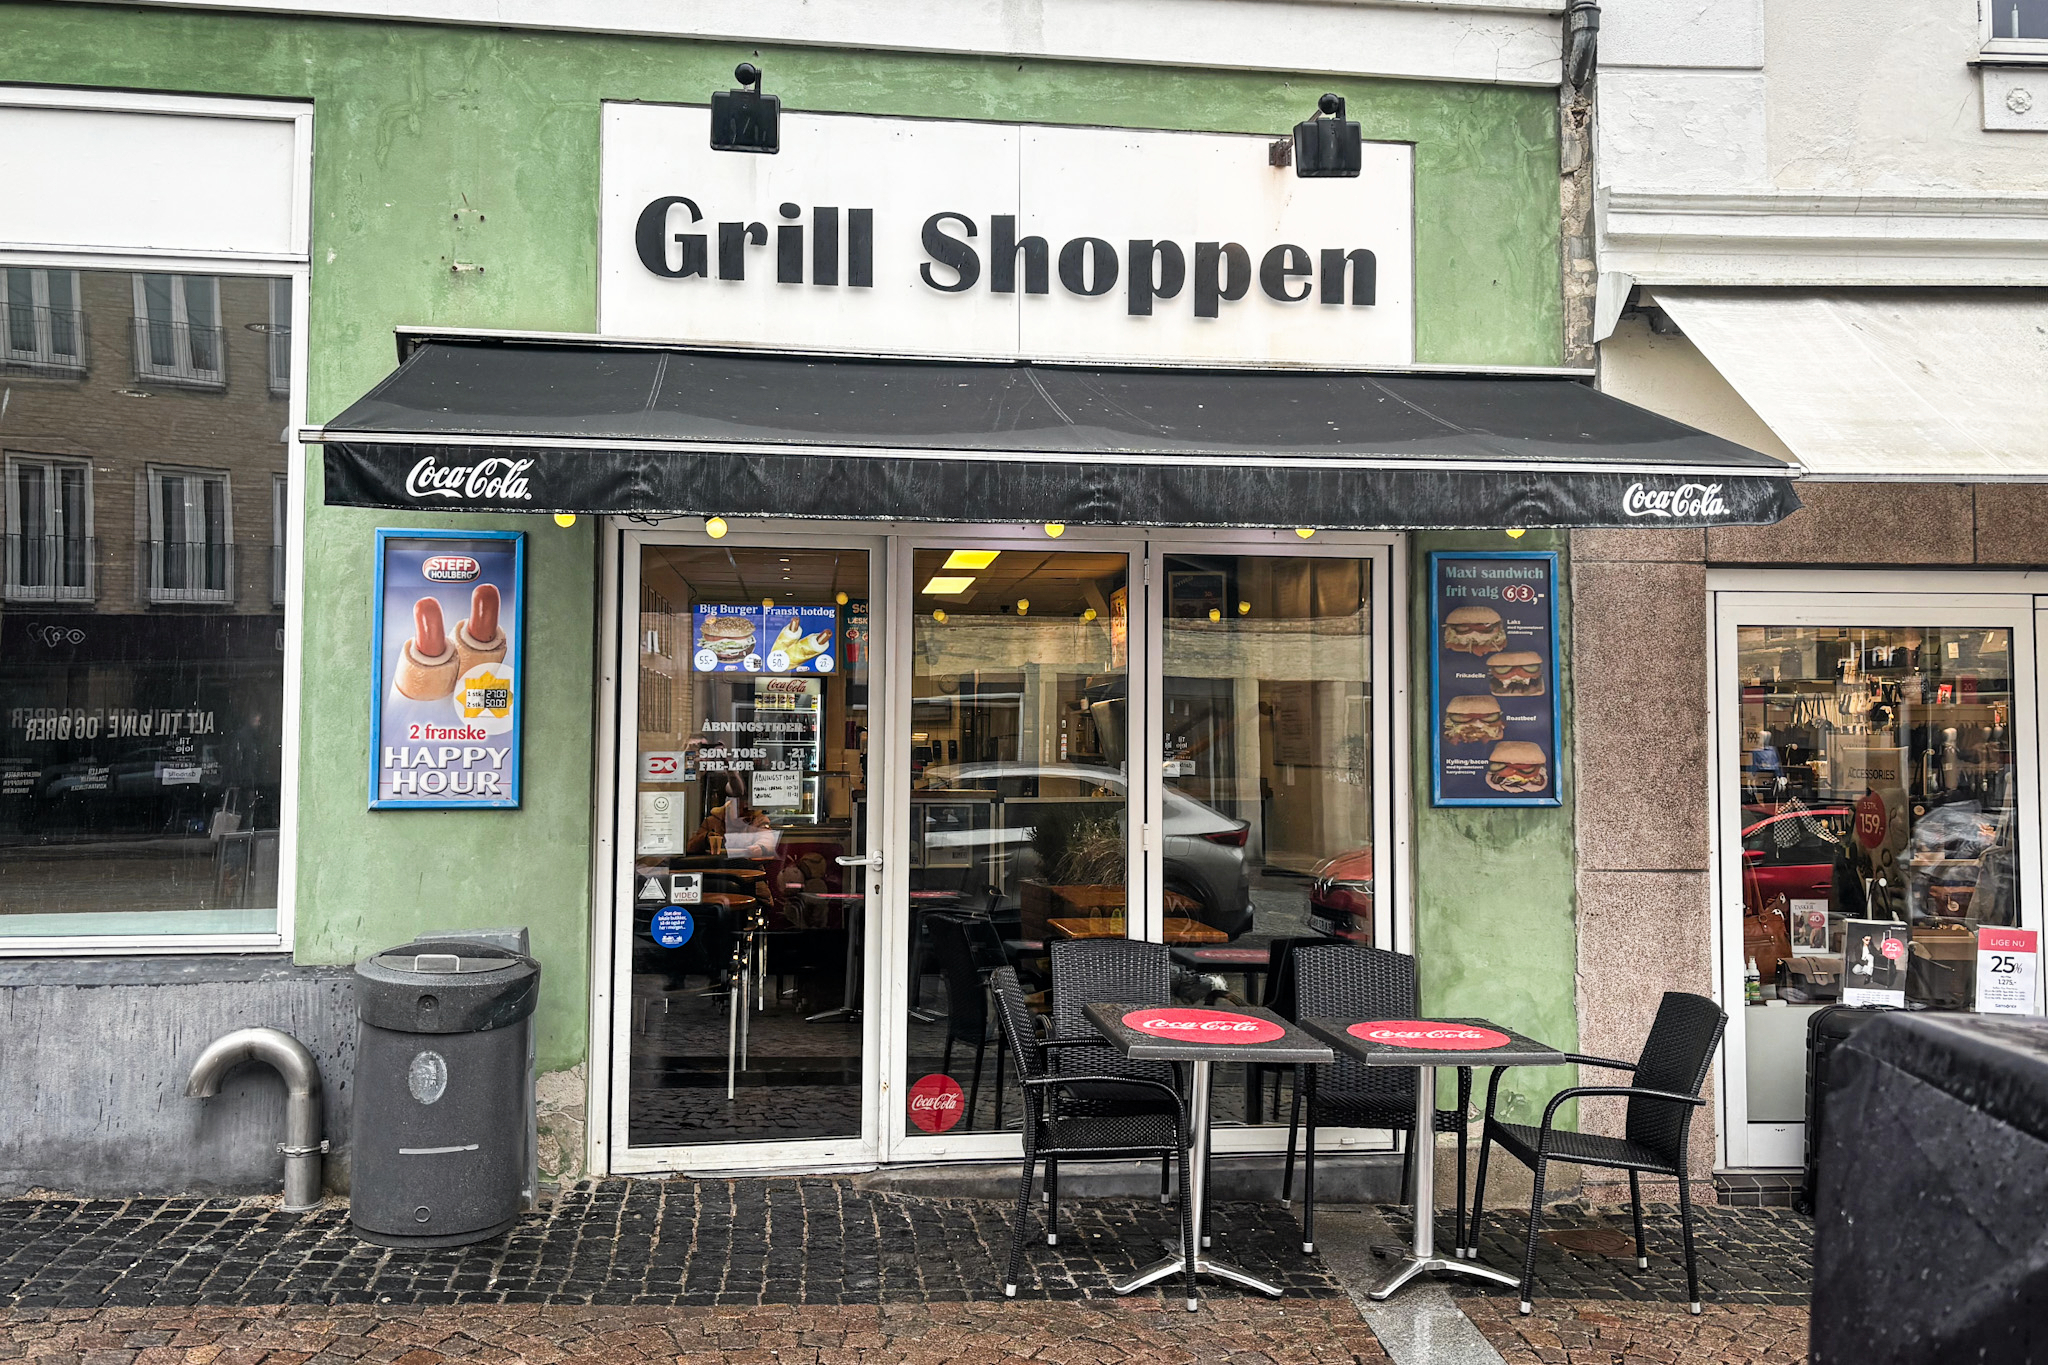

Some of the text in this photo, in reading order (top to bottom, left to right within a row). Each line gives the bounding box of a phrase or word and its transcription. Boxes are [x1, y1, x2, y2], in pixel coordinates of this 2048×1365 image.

[635, 195, 1377, 319] Grill Shoppen
[405, 455, 535, 500] Coca-Cola
[1622, 482, 1731, 517] Coca-Cola
[431, 558, 473, 571] STEFF
[431, 570, 473, 580] HOULBERG
[1445, 566, 1544, 579] Maxi sandwich
[1445, 585, 1499, 600] frit valg
[699, 603, 758, 616] Big Burger
[765, 606, 835, 618] Fransk hotdog
[766, 679, 808, 693] Coca-Cola
[409, 723, 487, 740] 2 franske
[701, 718, 807, 733] ÅBNINGSTIDER:
[384, 746, 511, 770] HAPPY
[698, 747, 767, 759] SØN-TORS
[698, 760, 804, 772] FRE-LØR 10-21
[1847, 767, 1896, 781] ACCESSORIES
[391, 771, 503, 795] HOUR
[1859, 813, 1884, 835] 159,-
[674, 891, 698, 899] VIDEO
[1990, 939, 2025, 948] LIGE NU
[1990, 955, 2023, 975] 25%
[1142, 1018, 1260, 1033] Coca-Cola
[1369, 1029, 1484, 1040] Coca-Cola
[911, 1092, 960, 1111] Coca-Cola
